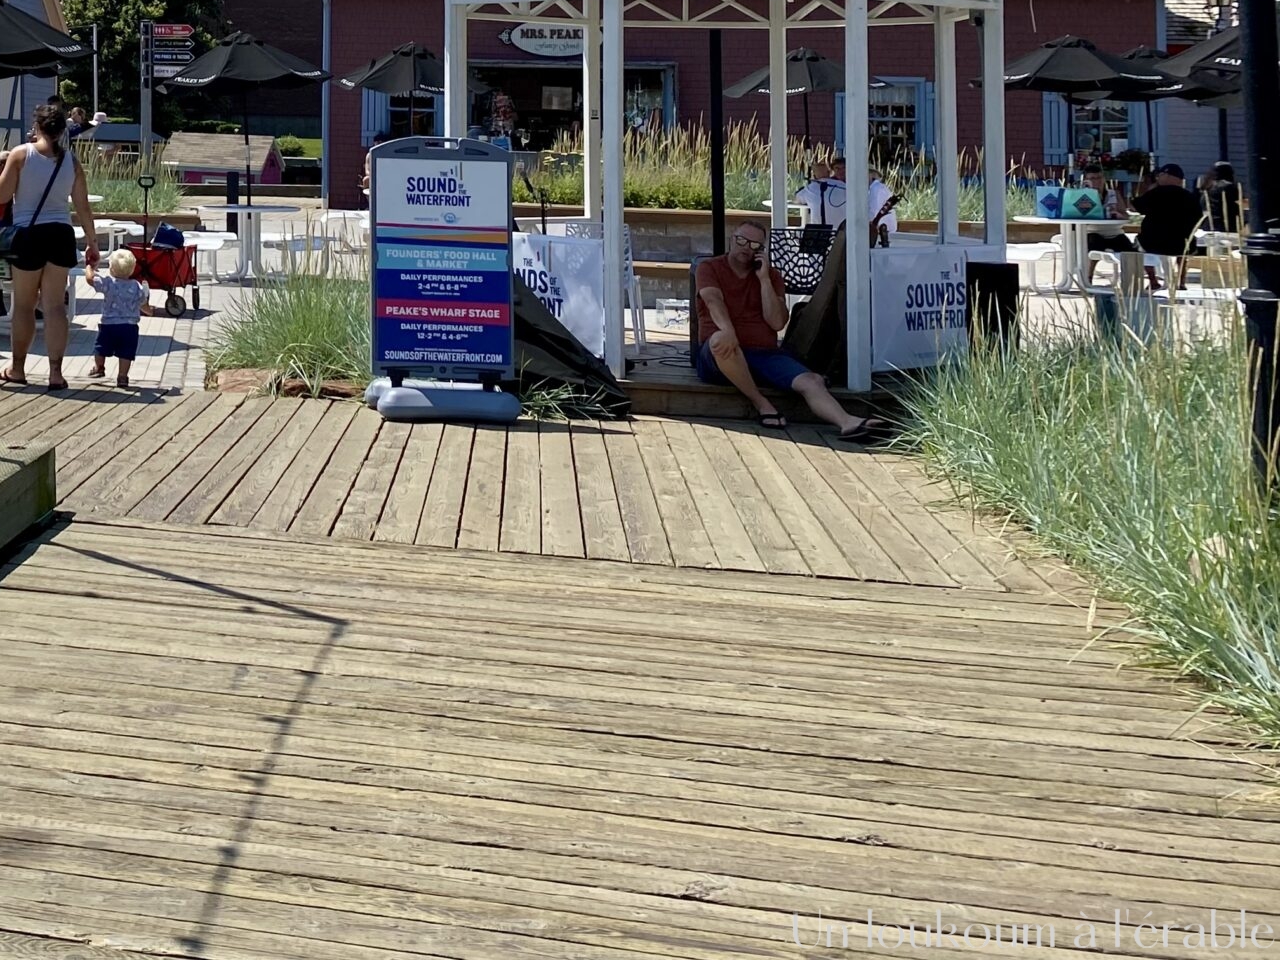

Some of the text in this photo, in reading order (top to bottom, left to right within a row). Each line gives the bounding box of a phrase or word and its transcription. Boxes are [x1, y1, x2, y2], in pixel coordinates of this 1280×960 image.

[520, 29, 583, 39] MRS. PEAK
[406, 177, 457, 193] SOUND
[406, 193, 471, 207] WATERFRONT
[386, 249, 497, 261] FOUNDERS' FOOD HALL
[416, 259, 468, 269] & MARKET
[523, 257, 533, 267] THE
[400, 273, 483, 283] DAILY PERFORMANCES
[940, 271, 950, 280] THE
[549, 276, 557, 286] OF
[549, 286, 561, 296] THE
[906, 282, 966, 309] SOUNDS
[386, 306, 500, 318] PEAKE'S WHARF STAGE
[422, 324, 483, 332] PERFORMANCES
[384, 350, 503, 363] SOUNDSOFTHEWATERFRONT.COM
